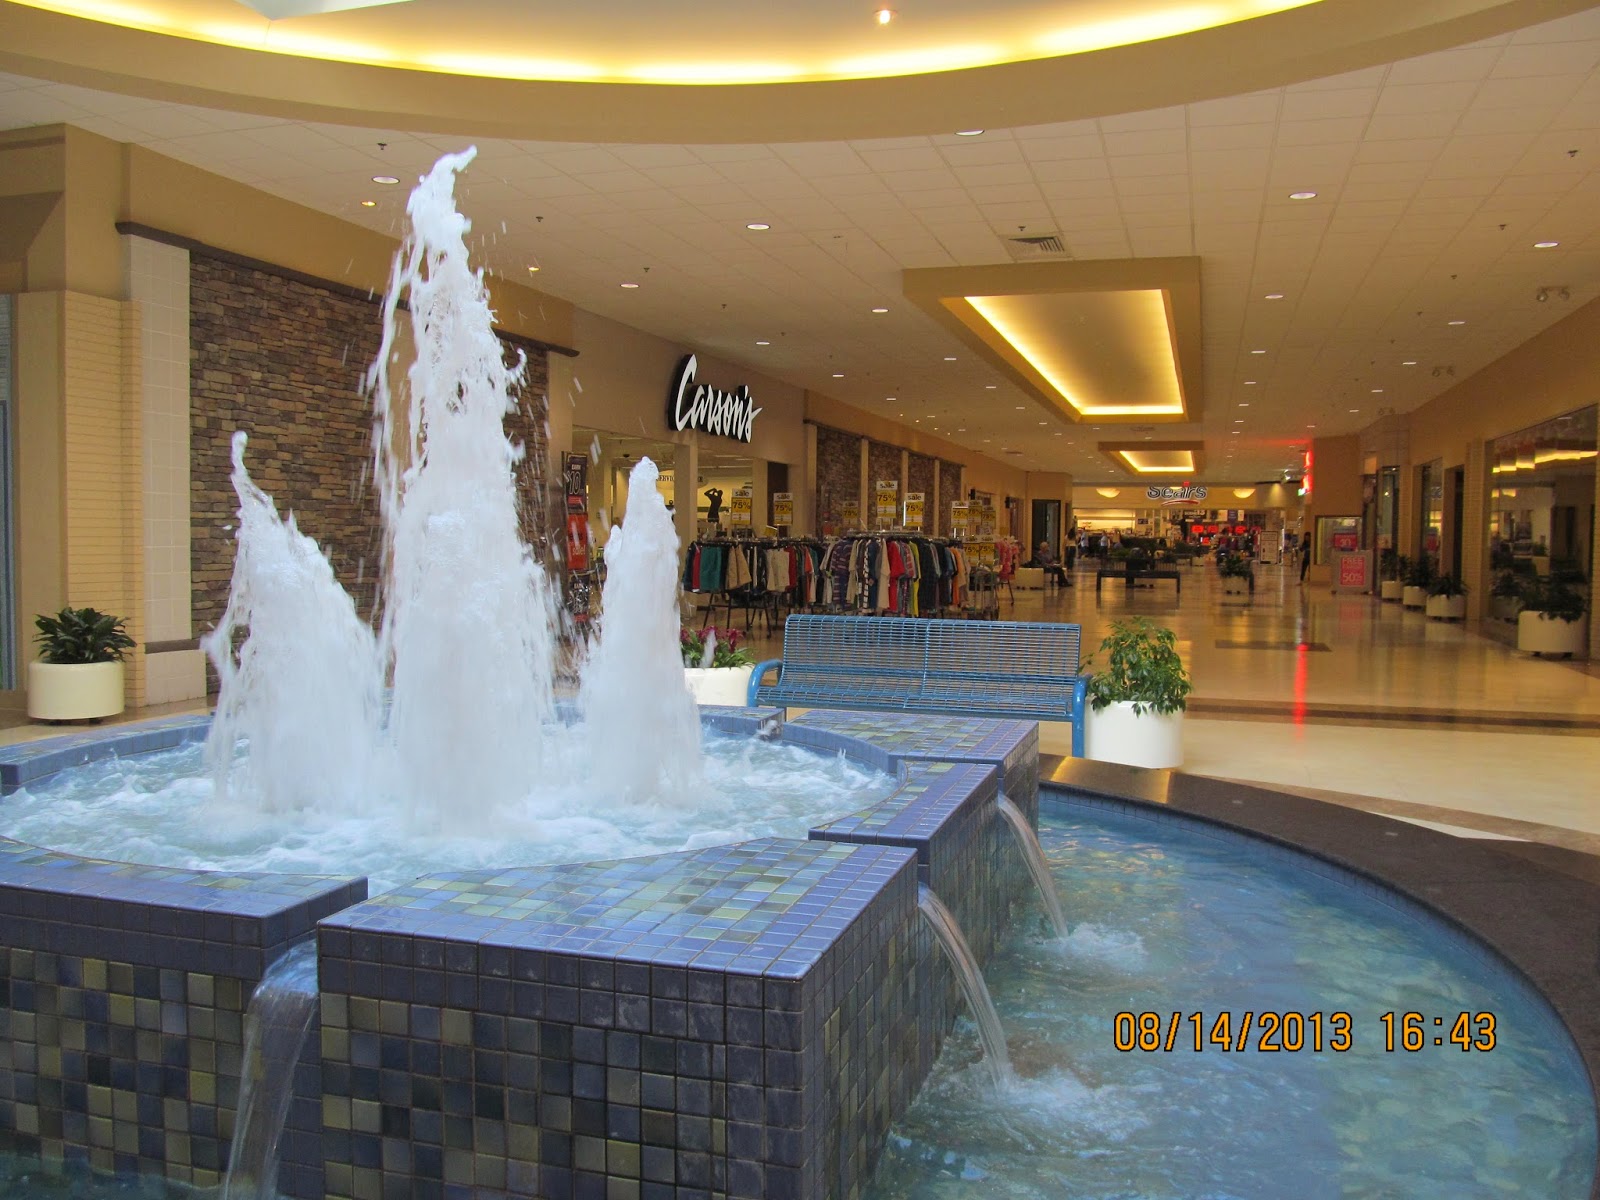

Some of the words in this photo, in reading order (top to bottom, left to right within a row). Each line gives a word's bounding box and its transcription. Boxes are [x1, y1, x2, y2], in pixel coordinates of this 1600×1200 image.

[675, 353, 763, 443] Carson's
[1147, 485, 1208, 499] Sears
[878, 494, 897, 502] 75%
[732, 501, 751, 509] 75%
[906, 504, 923, 512] 75%
